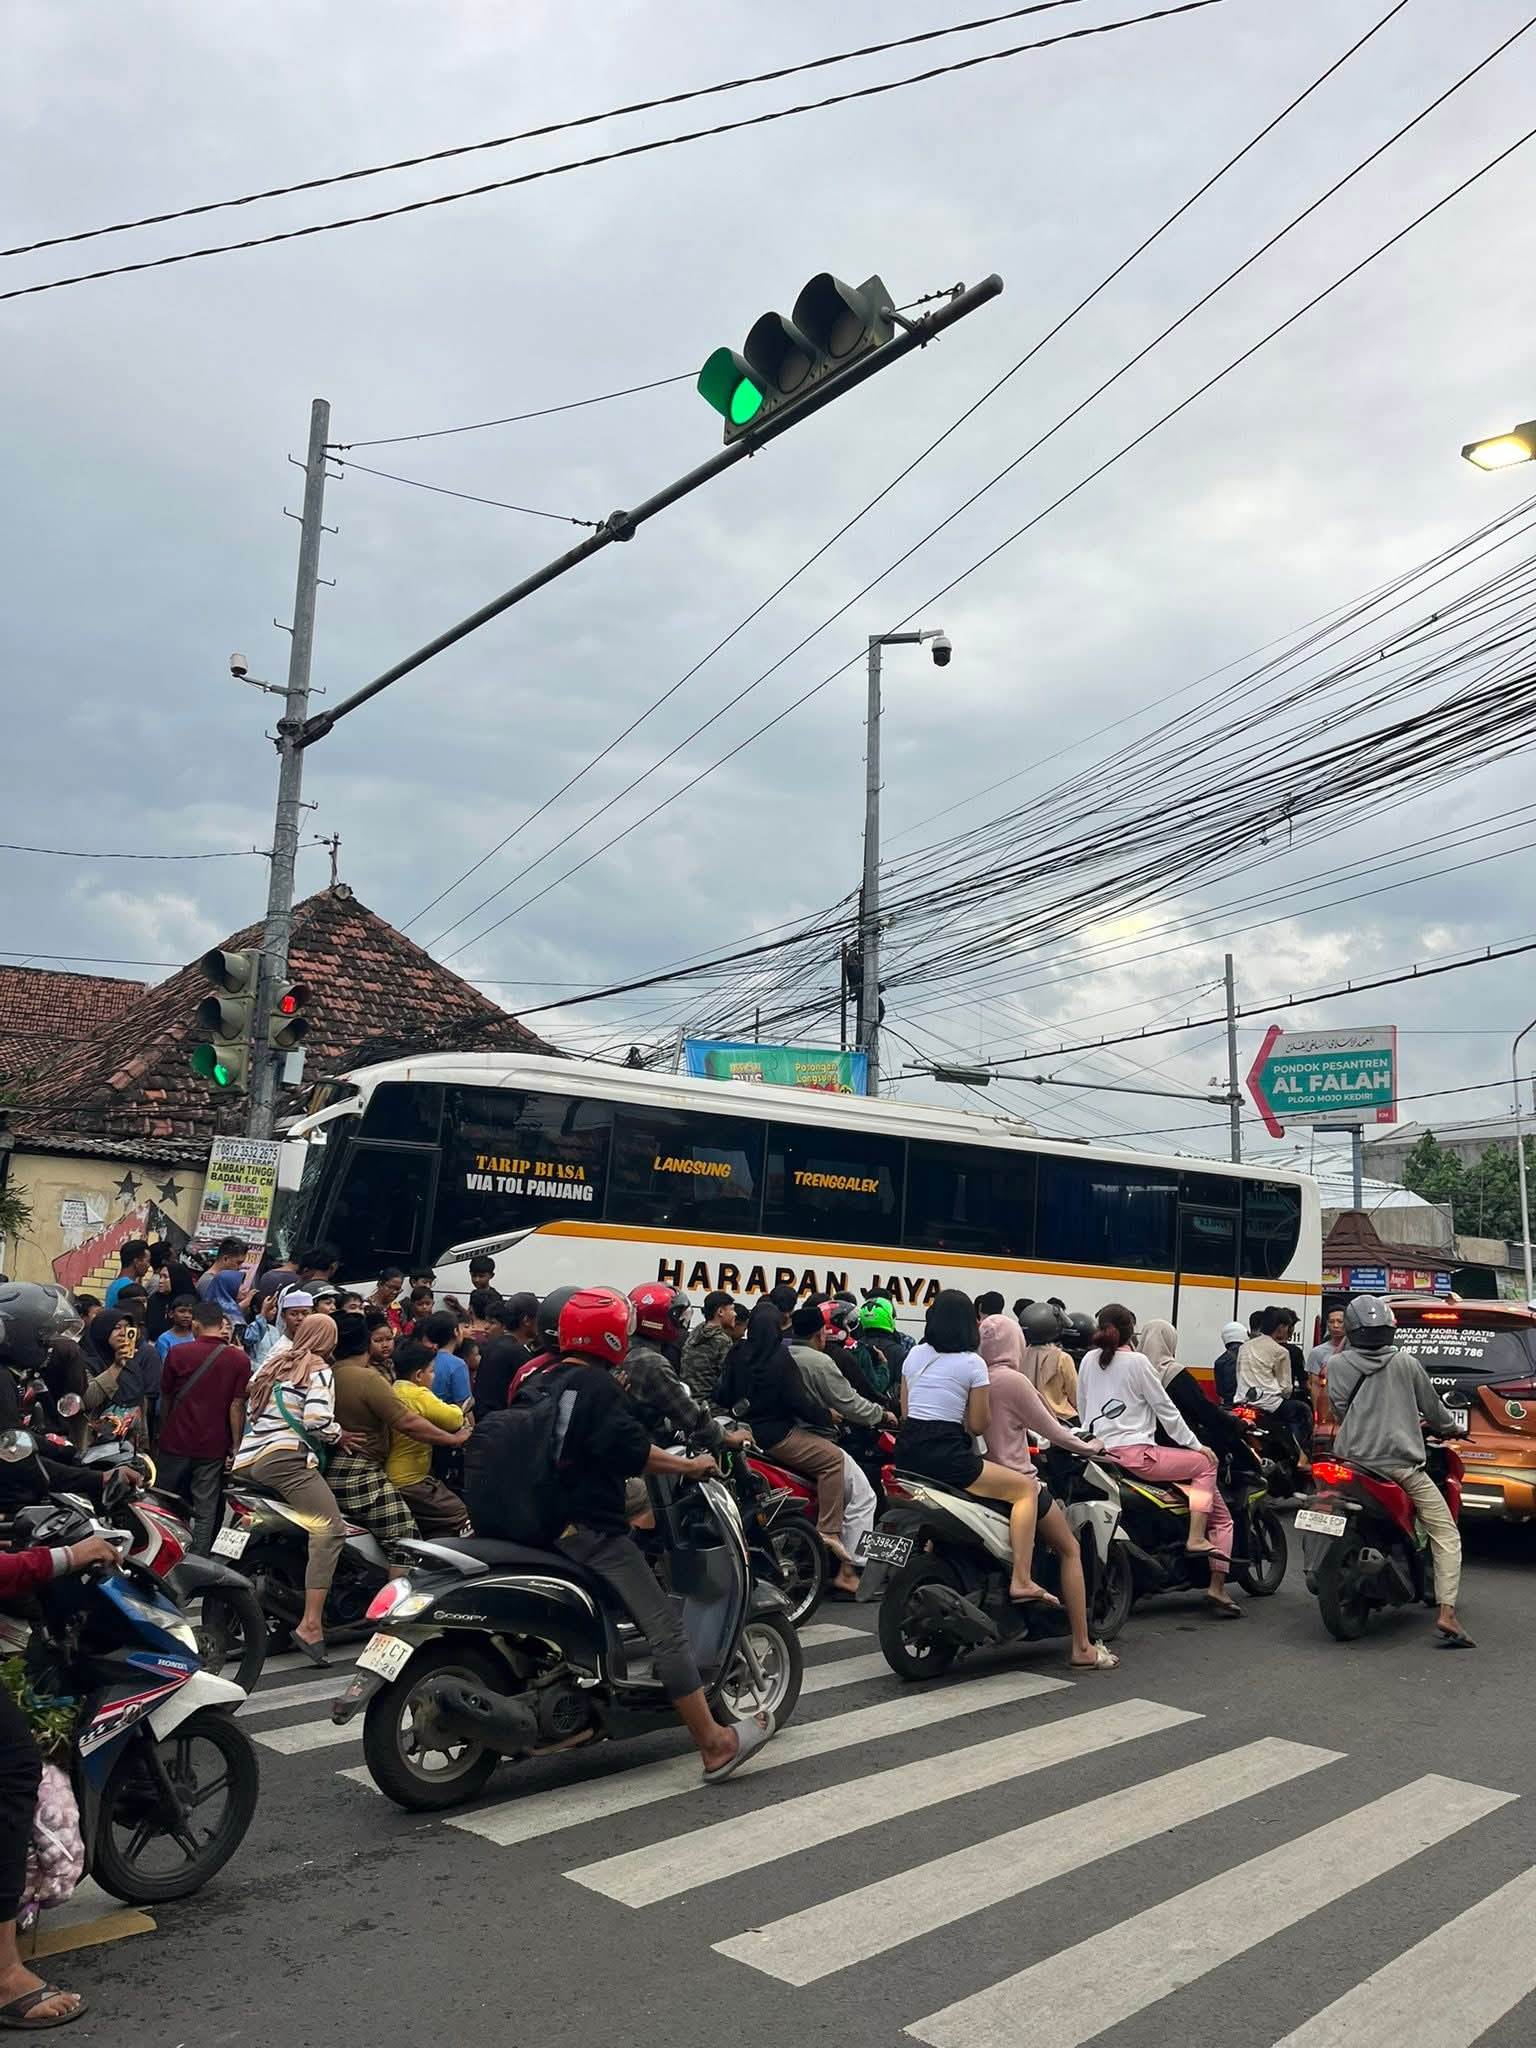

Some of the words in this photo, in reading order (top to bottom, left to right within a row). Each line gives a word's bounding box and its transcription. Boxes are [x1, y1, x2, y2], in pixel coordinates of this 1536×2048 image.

[1274, 1063, 1320, 1074] PONDOK
[1322, 1058, 1388, 1070] PESANTREN
[1272, 1077, 1302, 1094] AL
[1309, 1072, 1391, 1092] FALAH
[1288, 1095, 1315, 1104] PLOSO
[1317, 1094, 1342, 1102] MOJO
[1344, 1093, 1373, 1101] KEDIRI
[221, 1143, 239, 1156] 0812
[240, 1145, 258, 1158] 3532
[260, 1147, 278, 1160] 2675
[212, 1162, 245, 1174] TAMBAH
[247, 1166, 275, 1177] TINGGI
[248, 1158, 274, 1166] TERAPI
[476, 1155, 530, 1174] TARIP
[534, 1161, 585, 1181] BIASA
[653, 1156, 732, 1178] LANGSUNG
[210, 1172, 242, 1184] BADAN
[245, 1176, 257, 1185] 1-6
[260, 1178, 274, 1187] CM
[466, 1173, 493, 1191] VIA
[496, 1176, 524, 1195] TOL
[526, 1179, 594, 1201] PANJANG
[794, 1171, 879, 1193] TRENGGALEK
[224, 1183, 259, 1194] TERBUKTI
[236, 1194, 268, 1203] LANGSUNG
[656, 1258, 848, 1298] HARAPAN
[860, 1274, 943, 1306] JAYA
[1432, 1328, 1460, 1336] MOBIL
[1462, 1329, 1496, 1338] GRATIS
[1460, 1335, 1489, 1343] NYICIL
[1400, 1345, 1418, 1354] 085
[1420, 1346, 1439, 1354] 704
[1443, 1346, 1462, 1356] 705
[1464, 1348, 1484, 1357] 786
[390, 1644, 408, 1662] CT
[158, 1658, 188, 1670] HONDA
